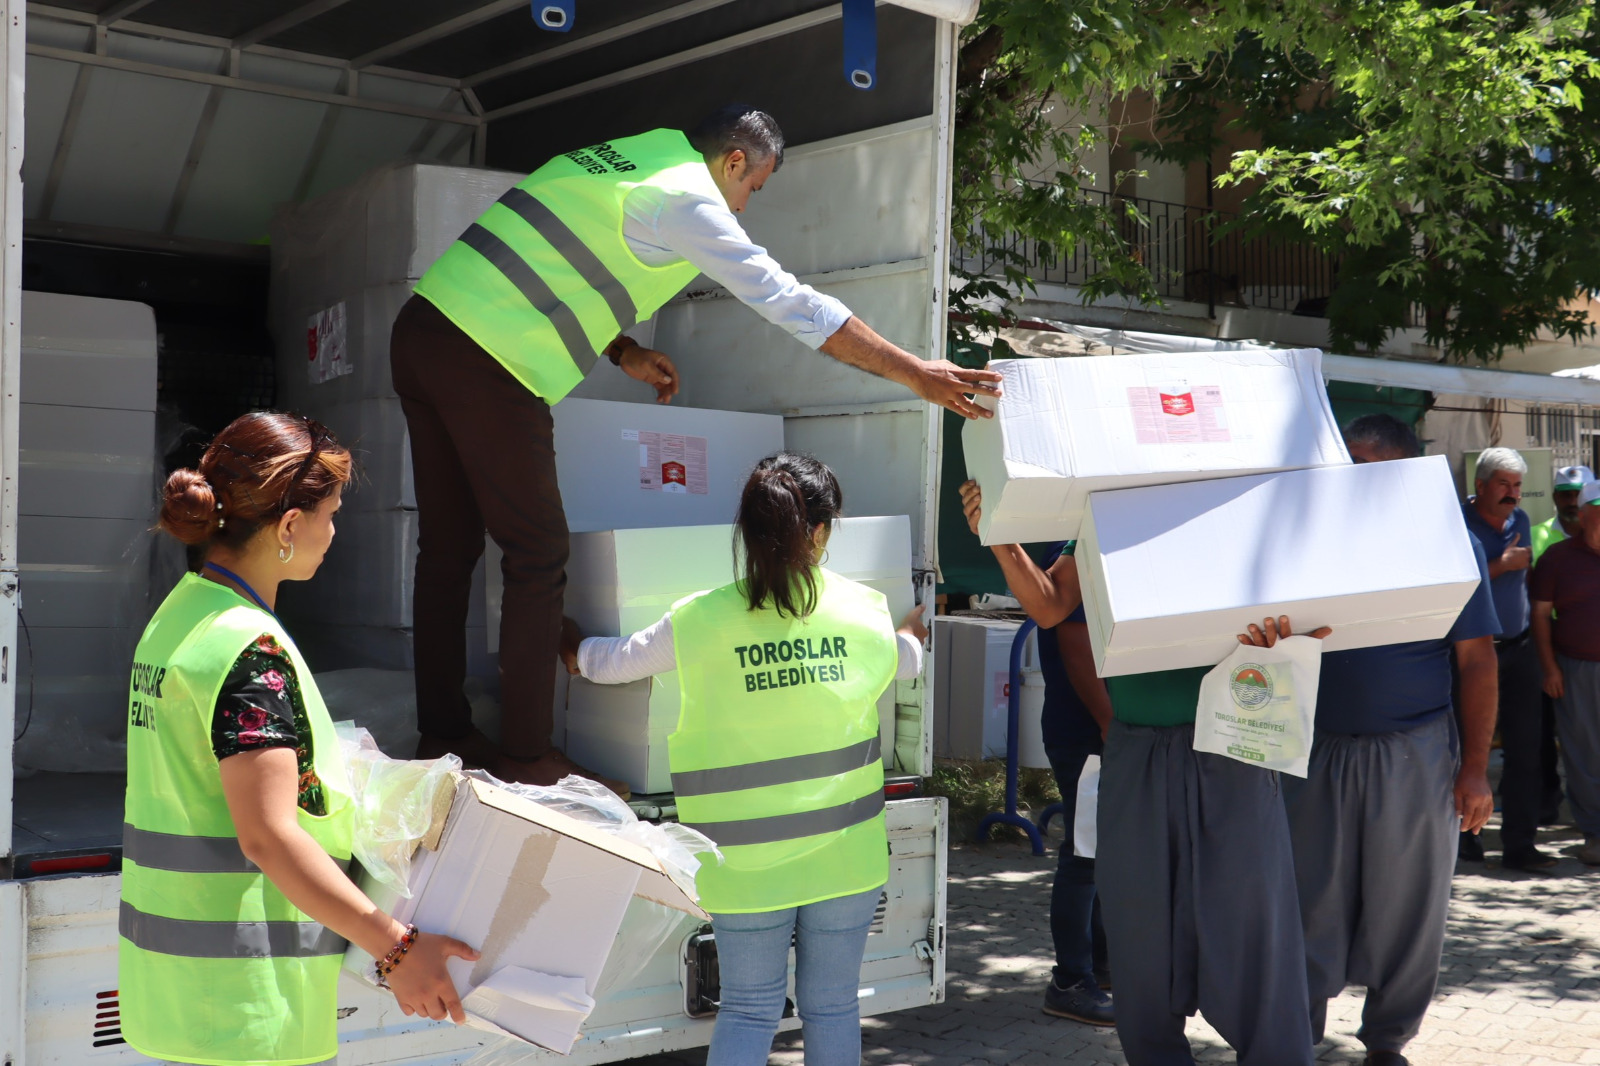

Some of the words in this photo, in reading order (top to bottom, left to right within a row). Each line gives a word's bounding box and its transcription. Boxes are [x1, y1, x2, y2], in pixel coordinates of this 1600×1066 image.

[734, 636, 848, 668] TOROSLAR
[744, 660, 846, 693] BELEDİYESİ
[1214, 711, 1247, 726] TOROSLAR
[1247, 719, 1285, 733] BELEDİYESİ
